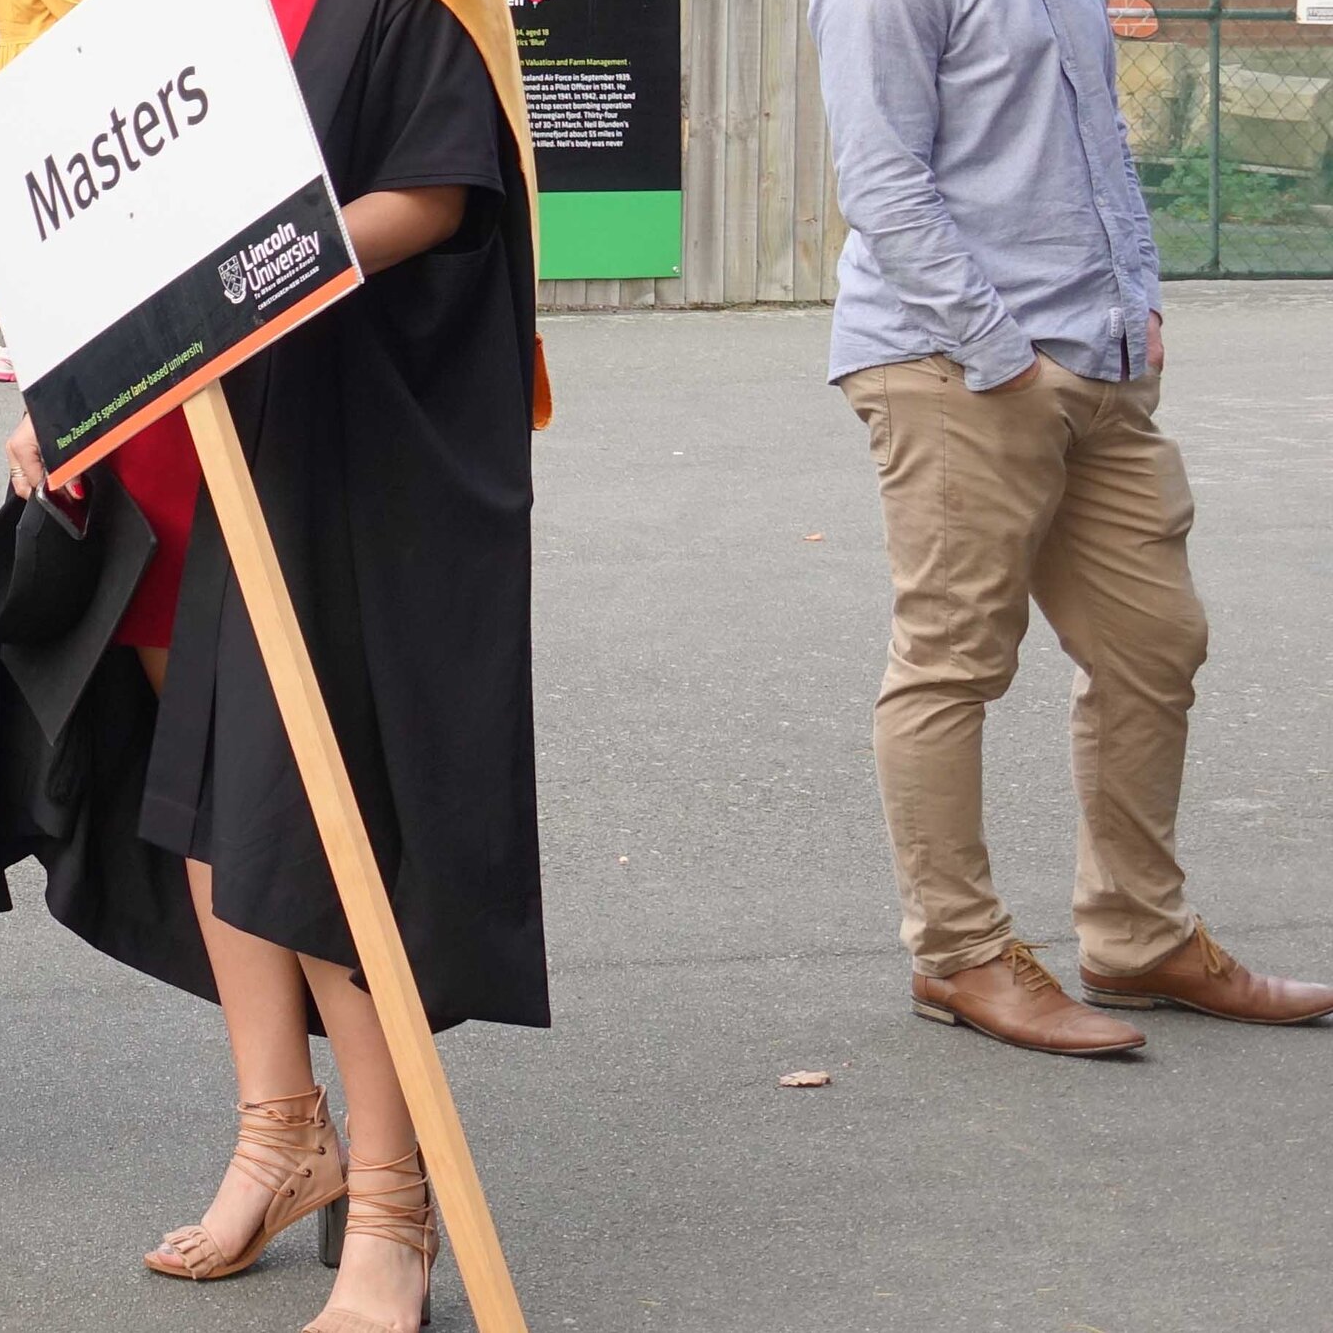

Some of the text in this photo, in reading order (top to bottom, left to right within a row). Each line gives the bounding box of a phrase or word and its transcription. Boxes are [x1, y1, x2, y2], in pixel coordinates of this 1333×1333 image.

[25, 66, 208, 242] Masters
[240, 222, 296, 271] Lincoln
[247, 231, 320, 291] University
[56, 341, 203, 449] New Zealand's specialist land-based university
